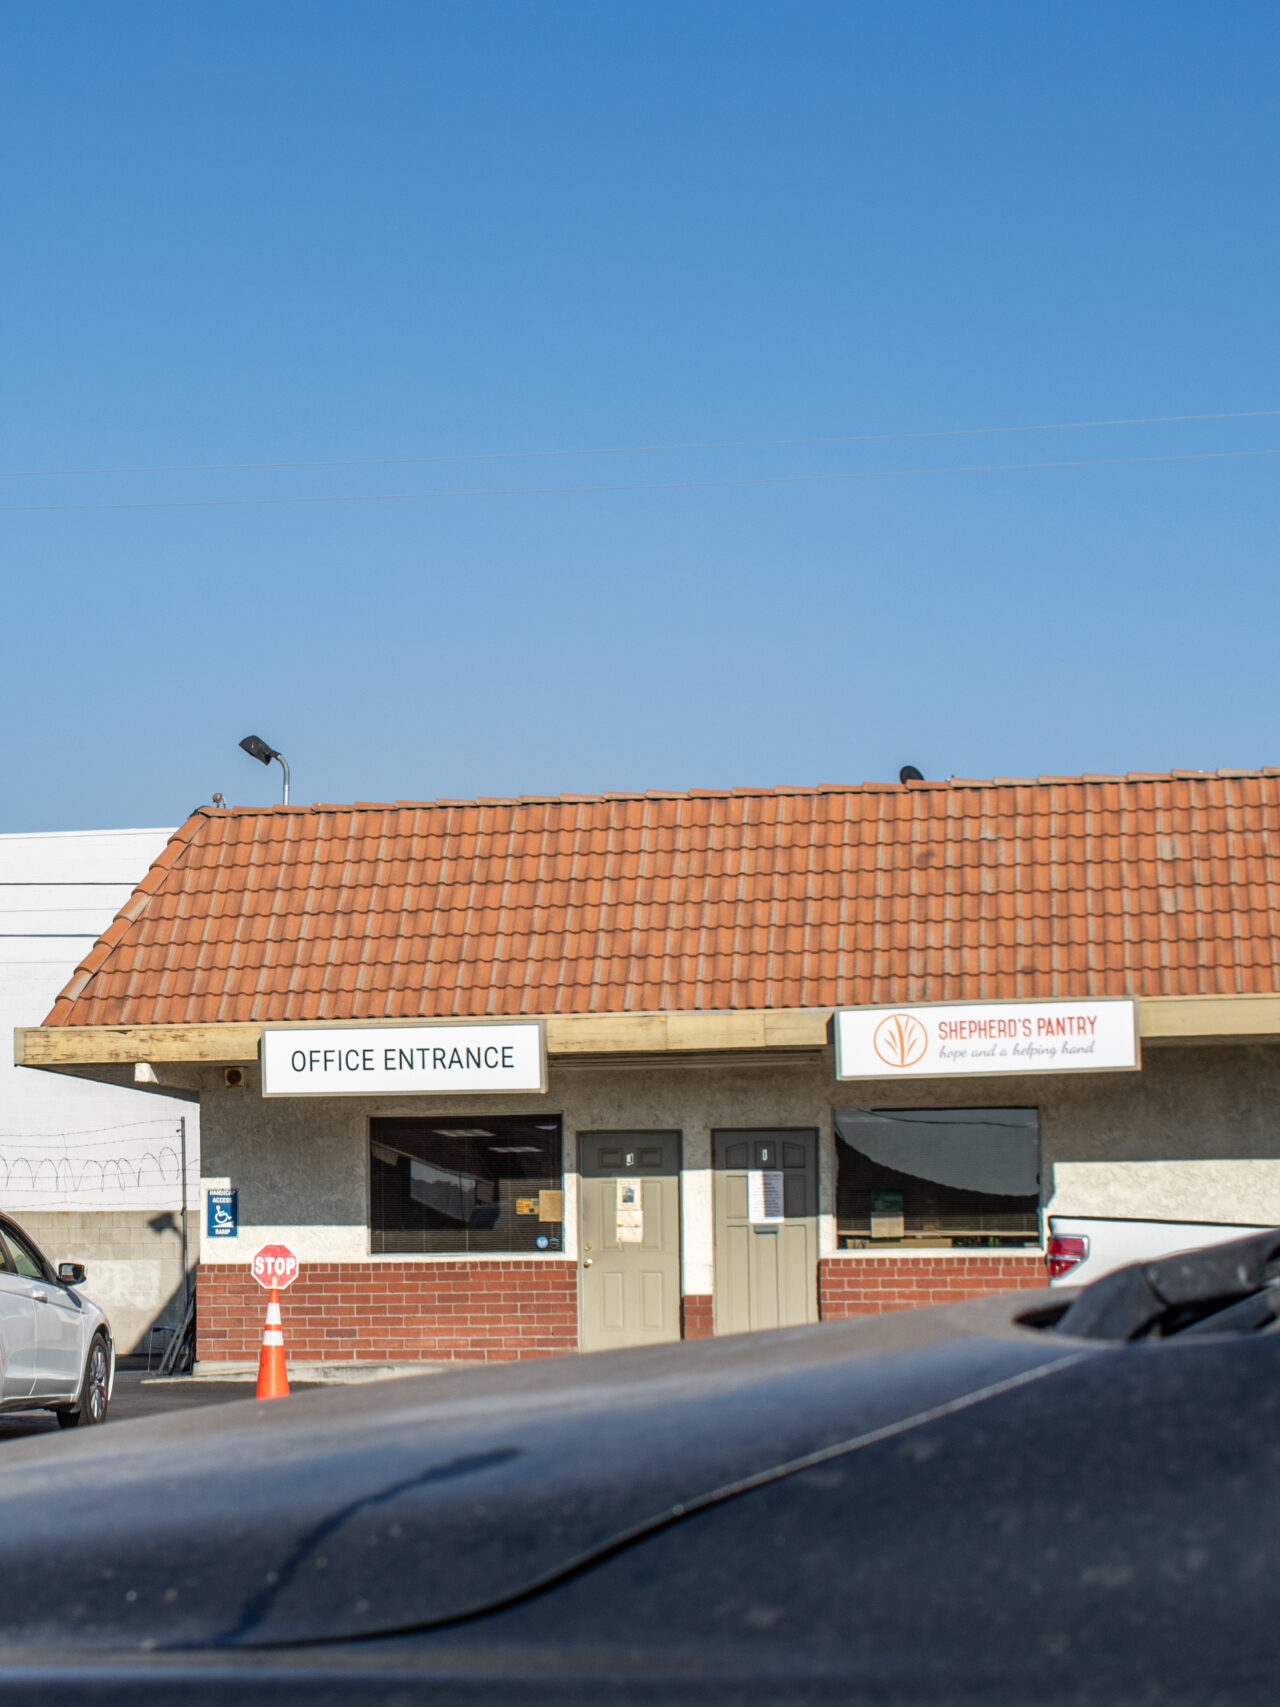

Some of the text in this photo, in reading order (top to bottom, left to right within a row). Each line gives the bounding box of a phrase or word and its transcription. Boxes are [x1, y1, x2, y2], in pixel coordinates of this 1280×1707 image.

[938, 1015, 1098, 1040] SHEPHERD'S PANTRY
[291, 1046, 515, 1072] OFFICE ENTRANCE
[938, 1039, 1096, 1062] hope and a helping hand
[255, 1256, 296, 1275] STOP
